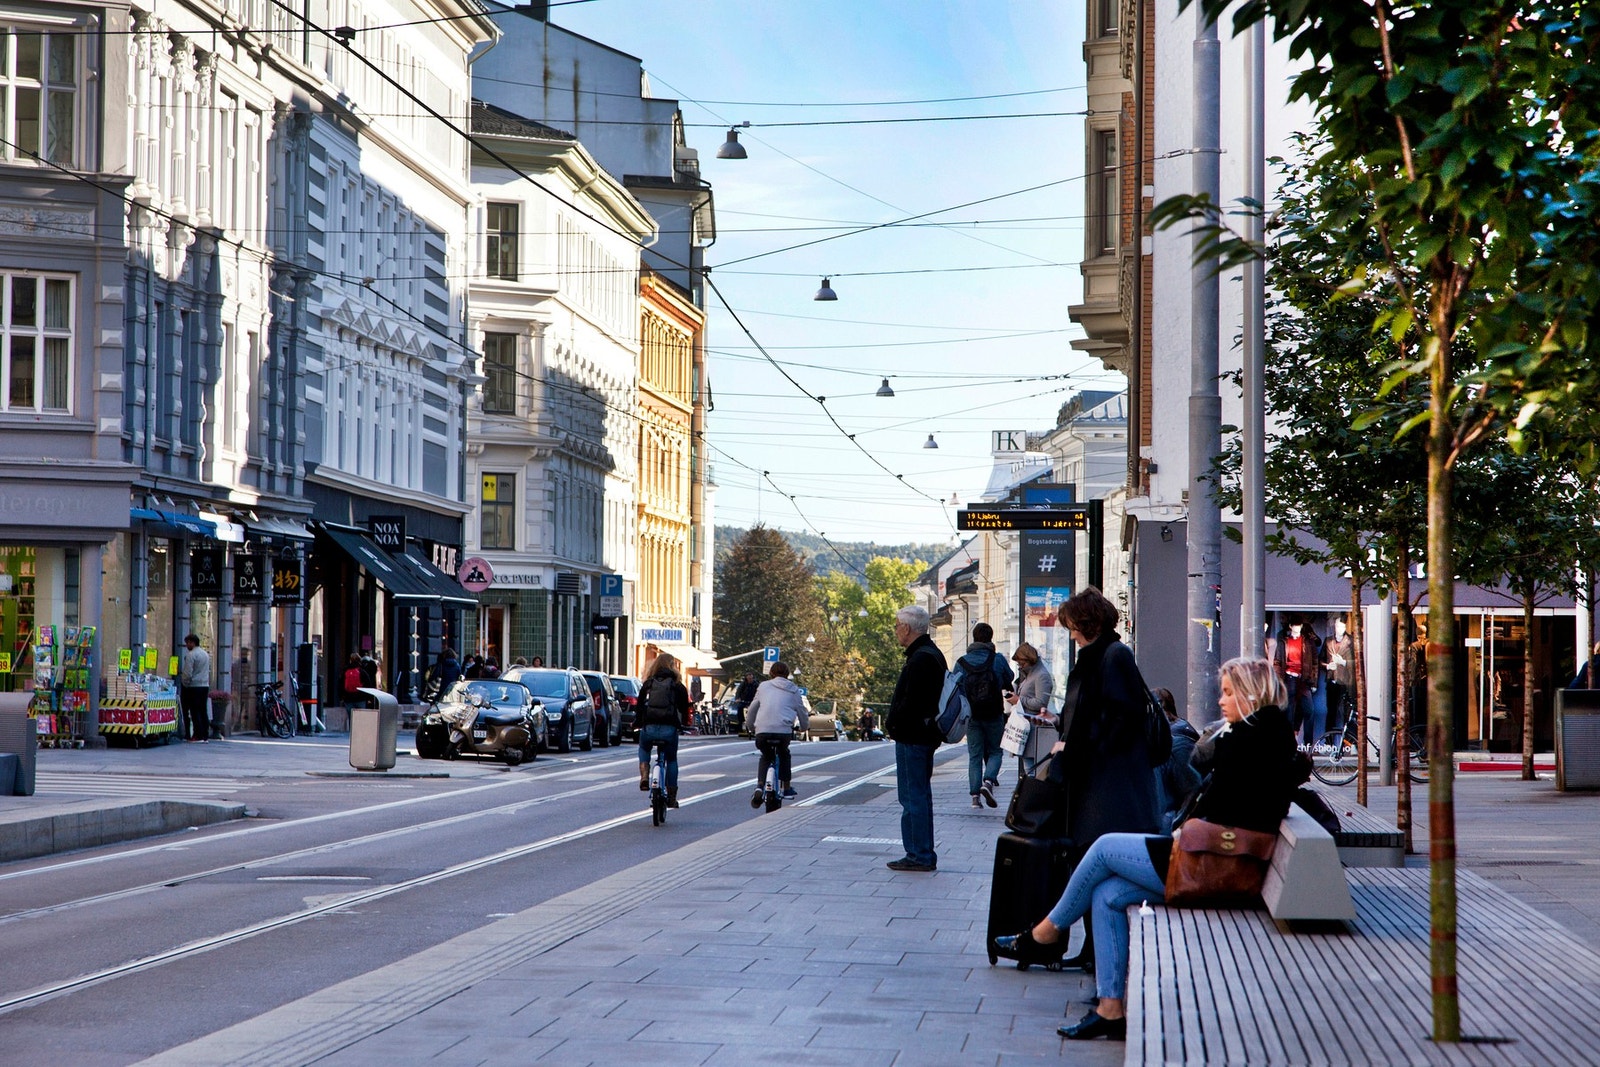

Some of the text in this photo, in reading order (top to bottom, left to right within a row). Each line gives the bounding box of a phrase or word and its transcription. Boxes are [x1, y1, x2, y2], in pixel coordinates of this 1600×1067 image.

[997, 432, 1020, 450] HK
[374, 523, 400, 534] NOA
[374, 534, 400, 545] NOA
[1028, 538, 1068, 546] Bogstadveien
[240, 576, 258, 588] D-A
[513, 574, 541, 584] PYRET
[605, 576, 618, 594] P
[768, 649, 776, 660] P
